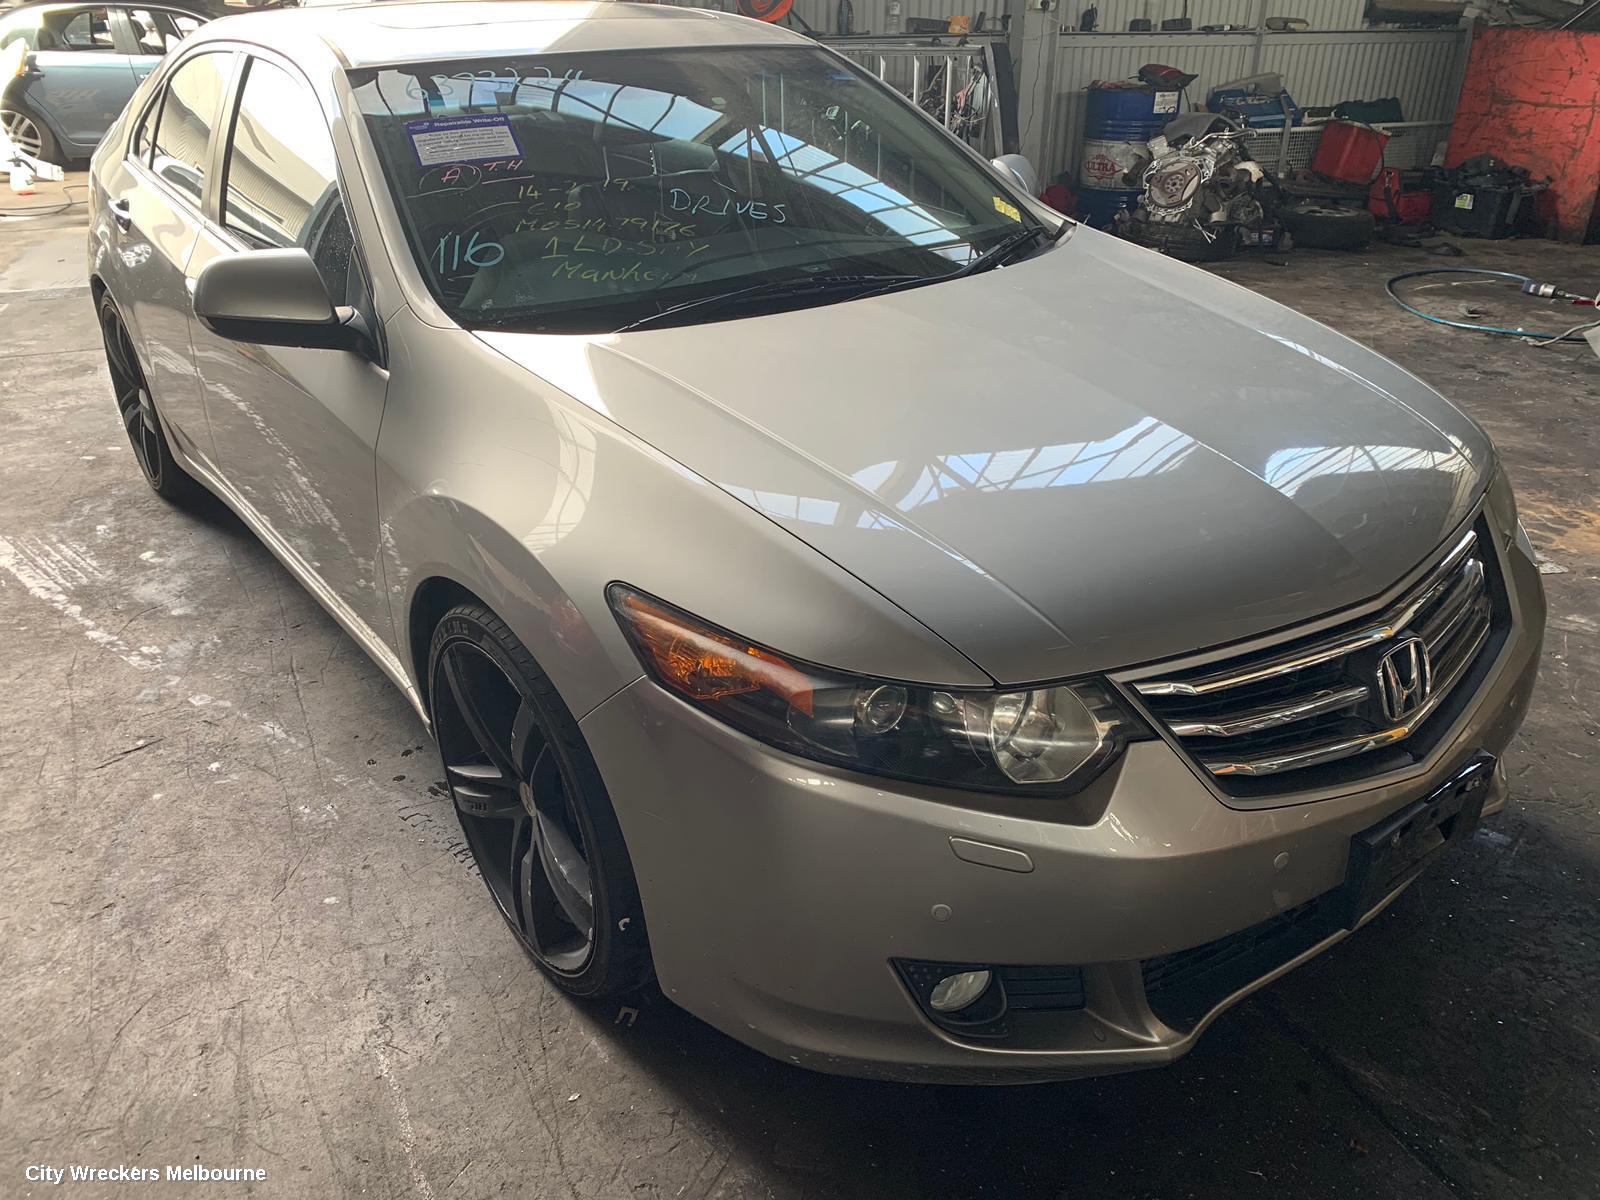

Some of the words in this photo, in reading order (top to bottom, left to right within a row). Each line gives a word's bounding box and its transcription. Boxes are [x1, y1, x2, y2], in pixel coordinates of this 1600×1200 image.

[1087, 161, 1116, 173] ULTRA
[670, 188, 786, 223] DRIVES
[439, 231, 505, 274] 116
